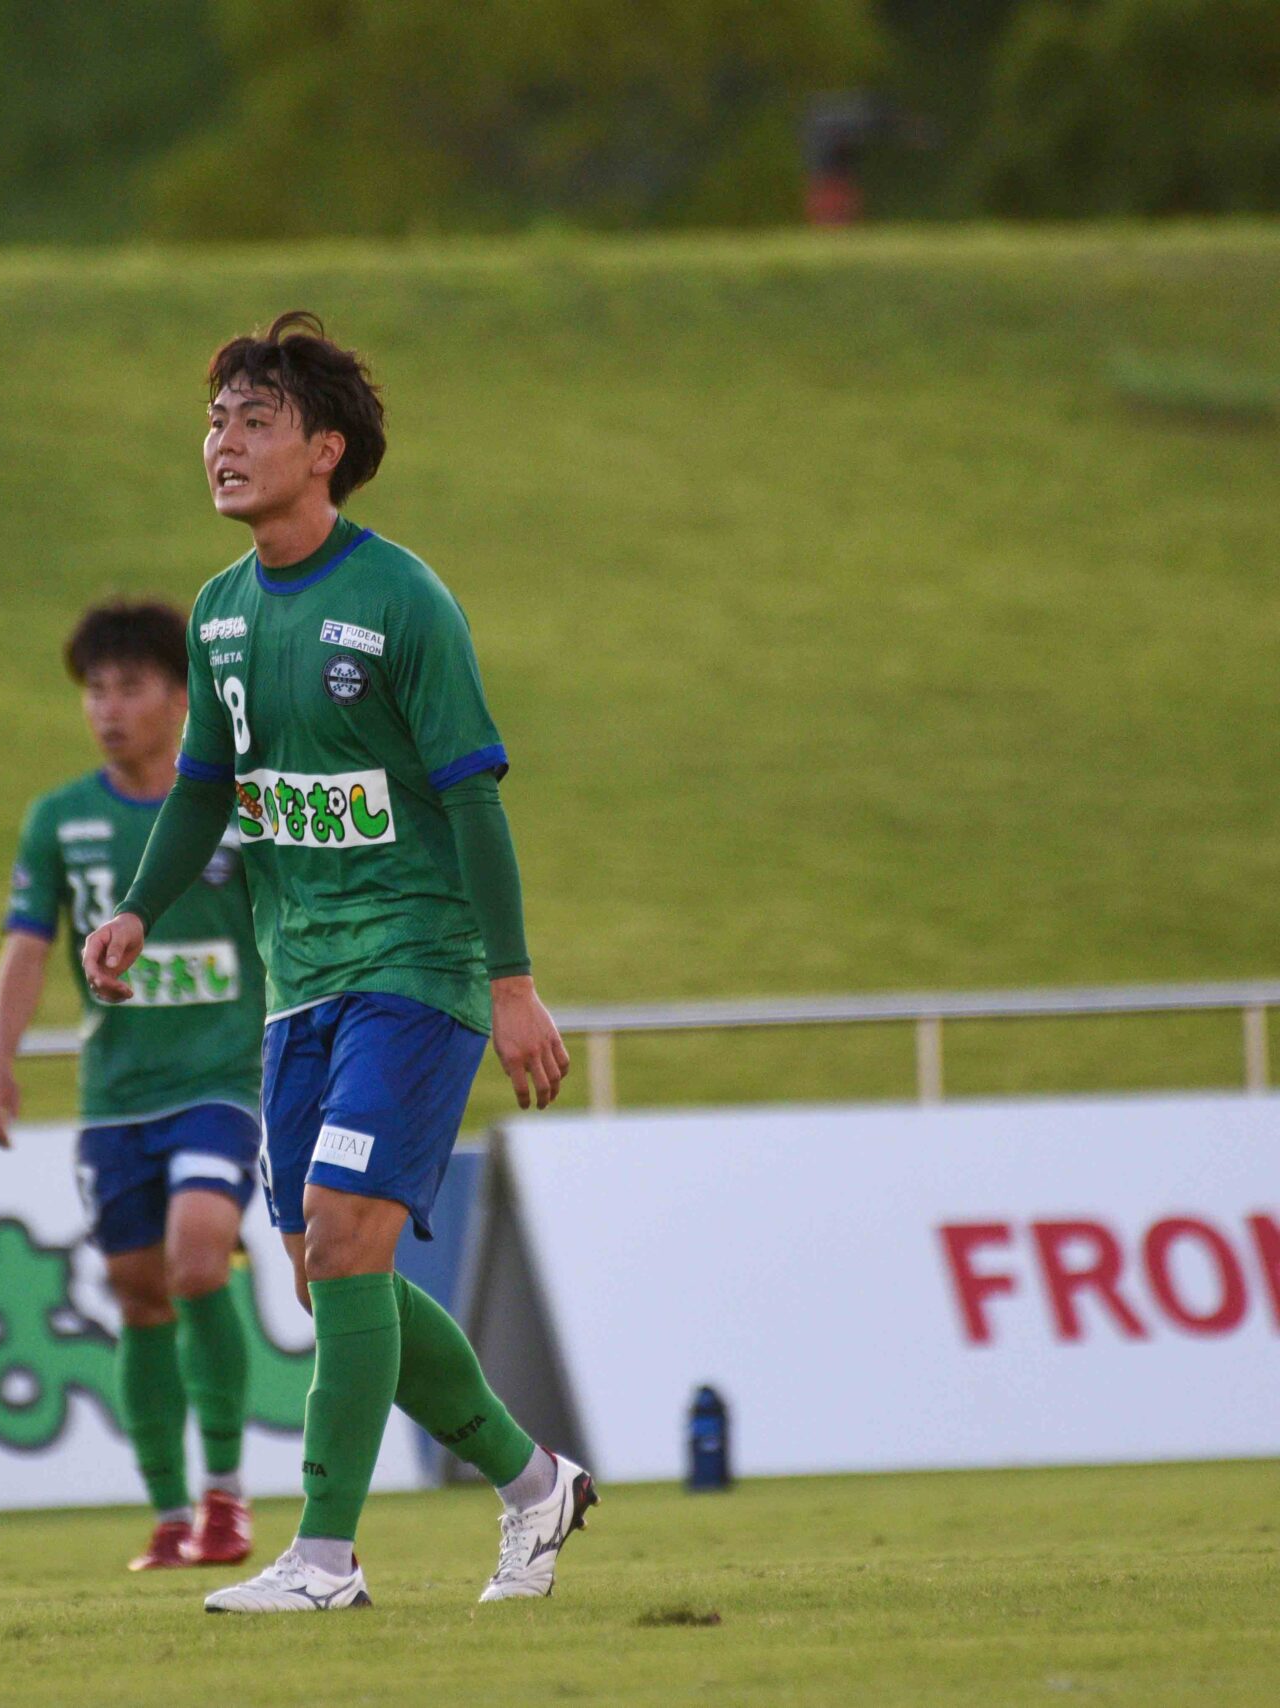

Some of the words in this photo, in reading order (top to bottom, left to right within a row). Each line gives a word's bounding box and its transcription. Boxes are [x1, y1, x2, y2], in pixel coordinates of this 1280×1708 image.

[345, 626, 382, 645] FUDEAL
[342, 638, 381, 655] CREATION
[214, 676, 251, 755] 8
